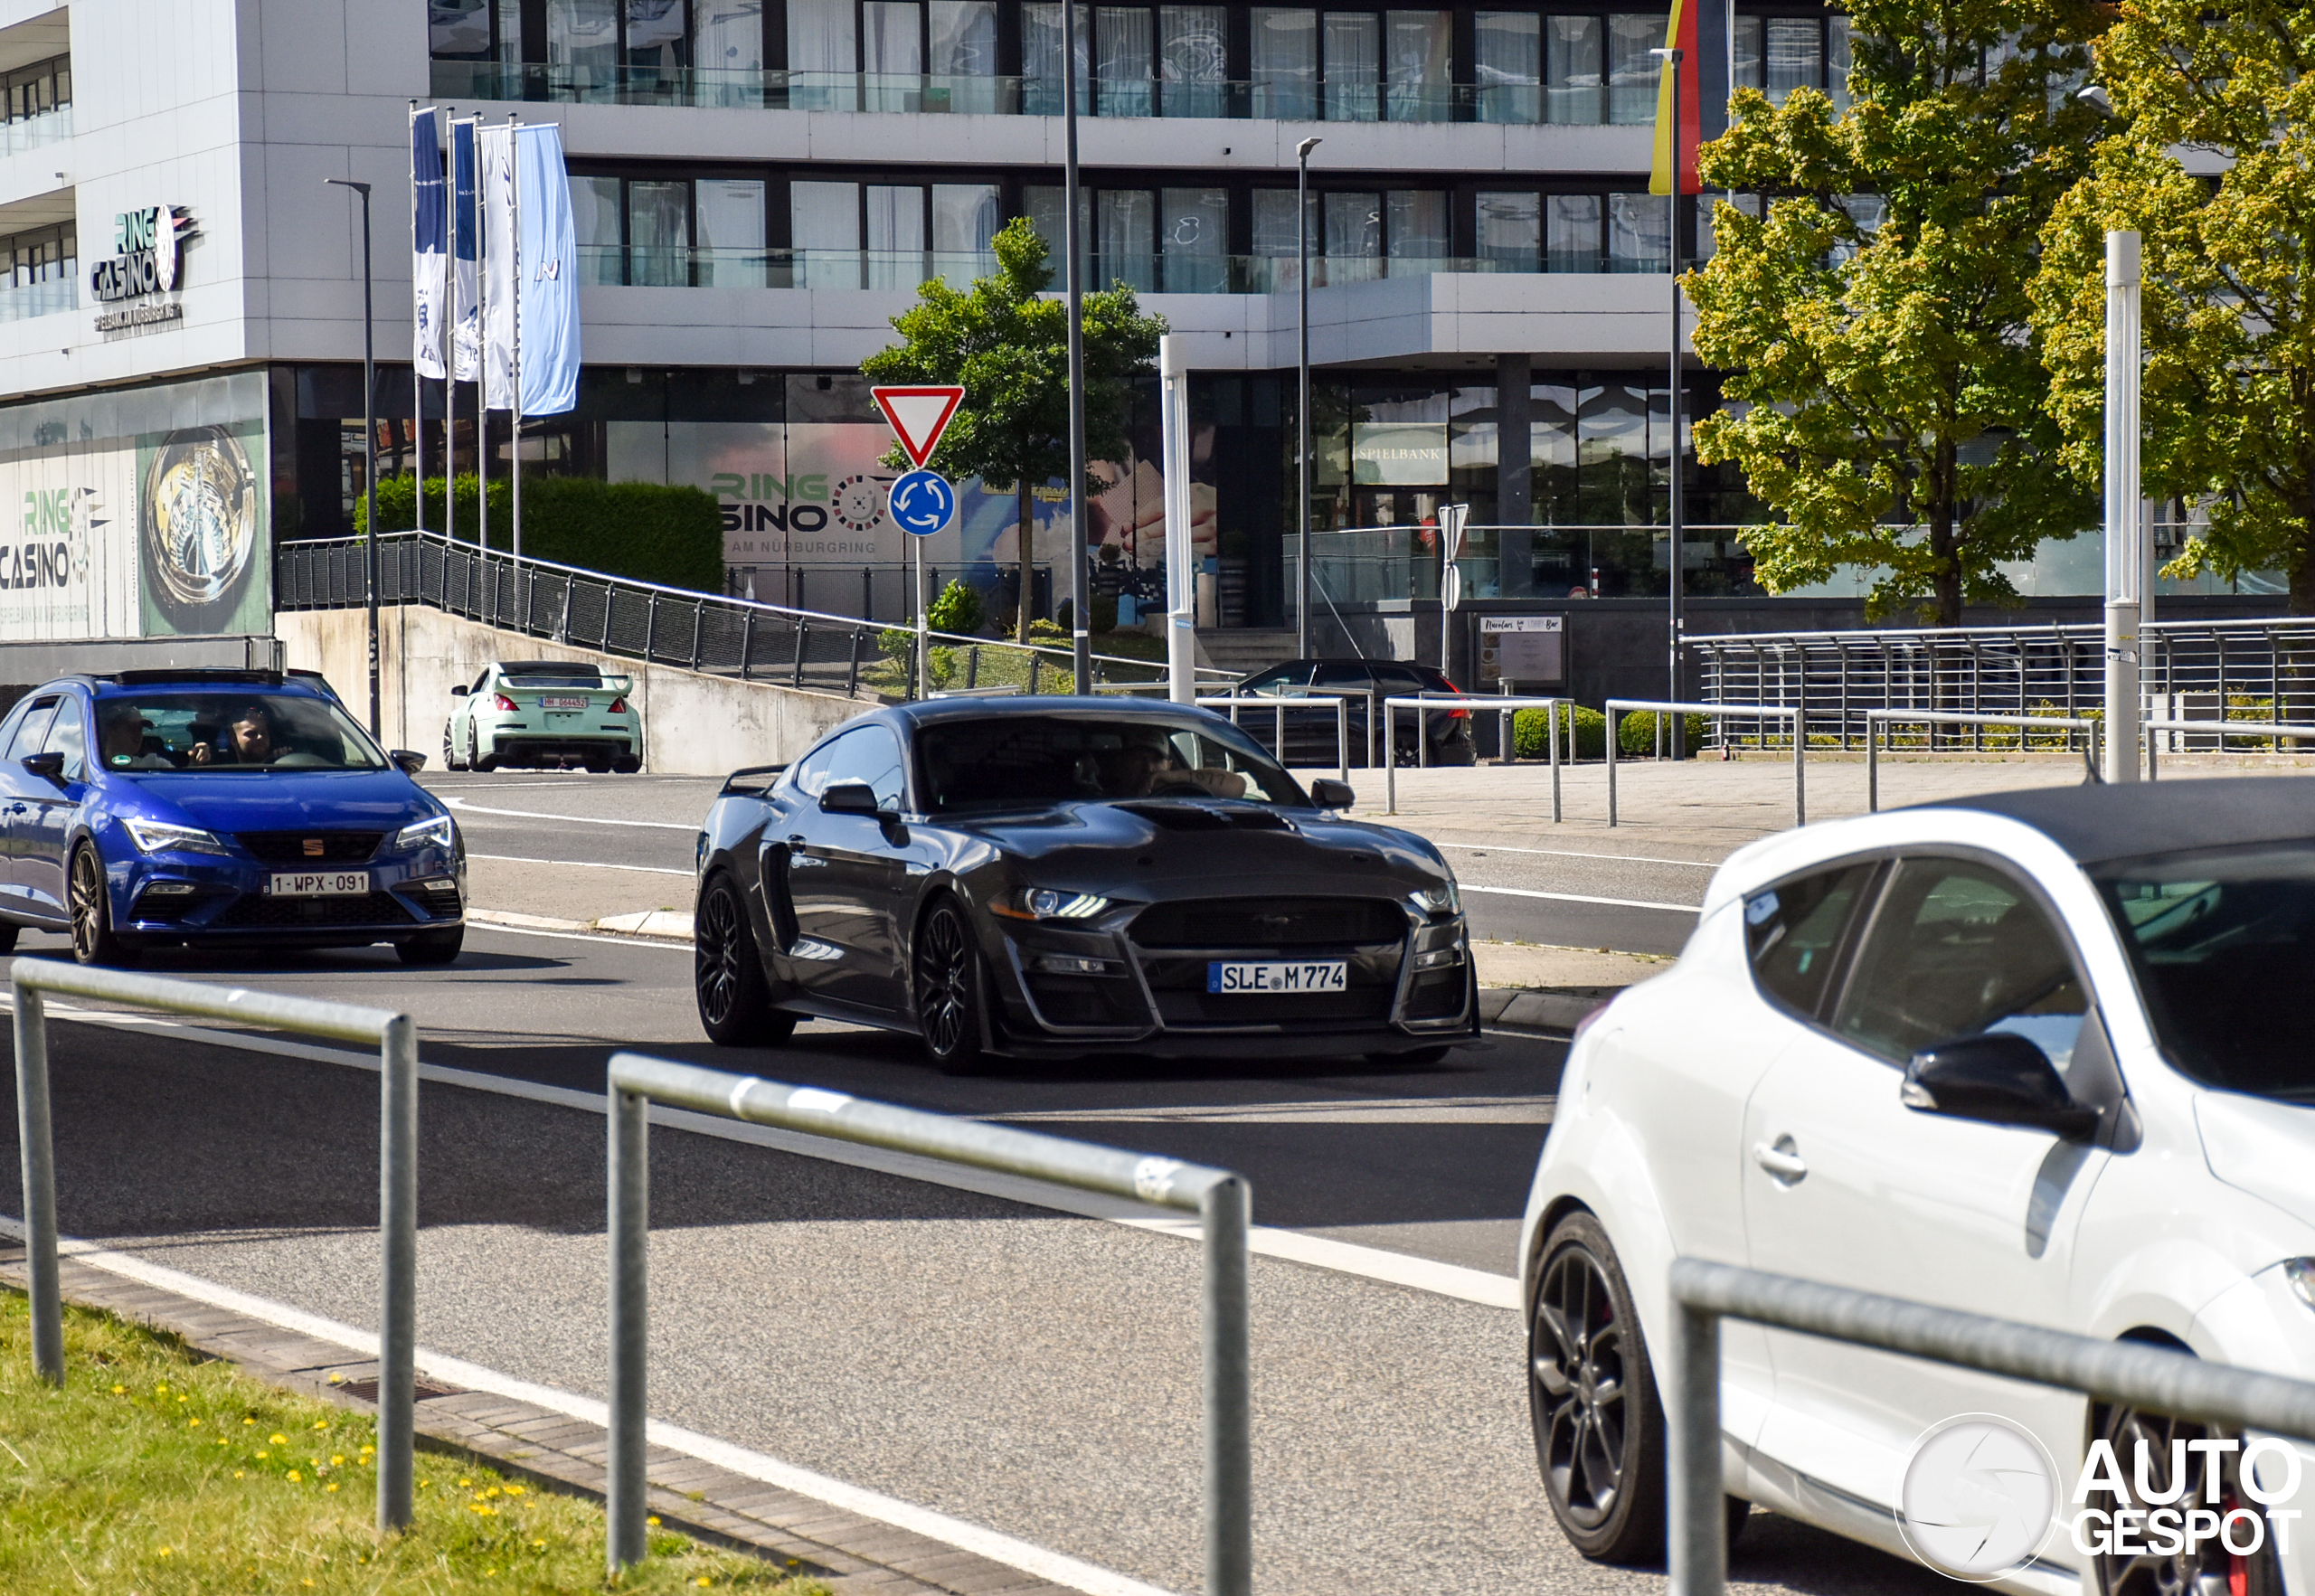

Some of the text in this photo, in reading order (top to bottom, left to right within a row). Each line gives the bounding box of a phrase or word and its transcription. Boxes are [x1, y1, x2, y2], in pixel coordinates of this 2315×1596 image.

[115, 206, 156, 254] RING
[90, 251, 156, 302] CASINO
[1359, 448, 1441, 459] SPIELBANK
[708, 473, 829, 501] RING
[24, 488, 69, 535] RING
[719, 505, 827, 532] SINO
[732, 539, 875, 553] AM NÜRBURGRING
[0, 543, 69, 590] CASINO
[544, 698, 554, 706] HH
[1224, 967, 1269, 990] SLE
